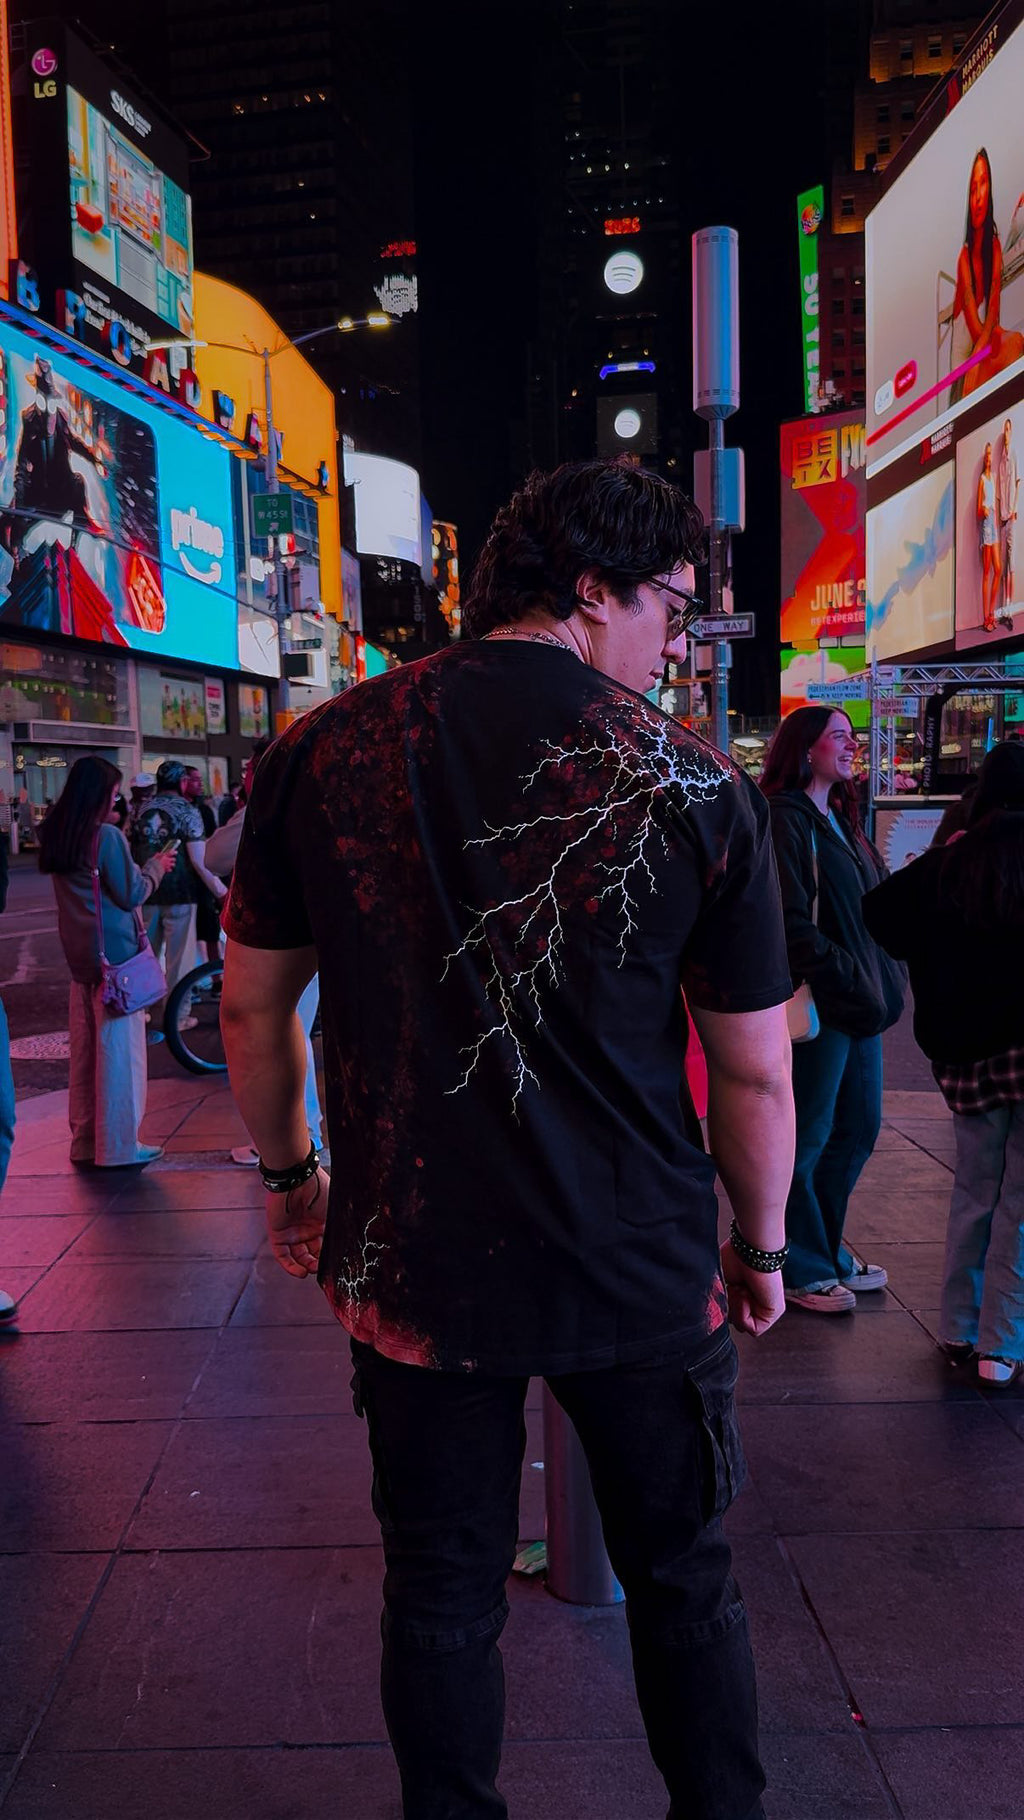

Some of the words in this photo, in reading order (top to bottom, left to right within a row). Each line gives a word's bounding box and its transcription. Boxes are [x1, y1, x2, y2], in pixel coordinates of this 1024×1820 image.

[33, 80, 57, 99] LG
[110, 89, 135, 127] SKS
[811, 580, 854, 611] JUNE
[693, 622, 713, 633] ONE
[723, 621, 744, 631] WAY
